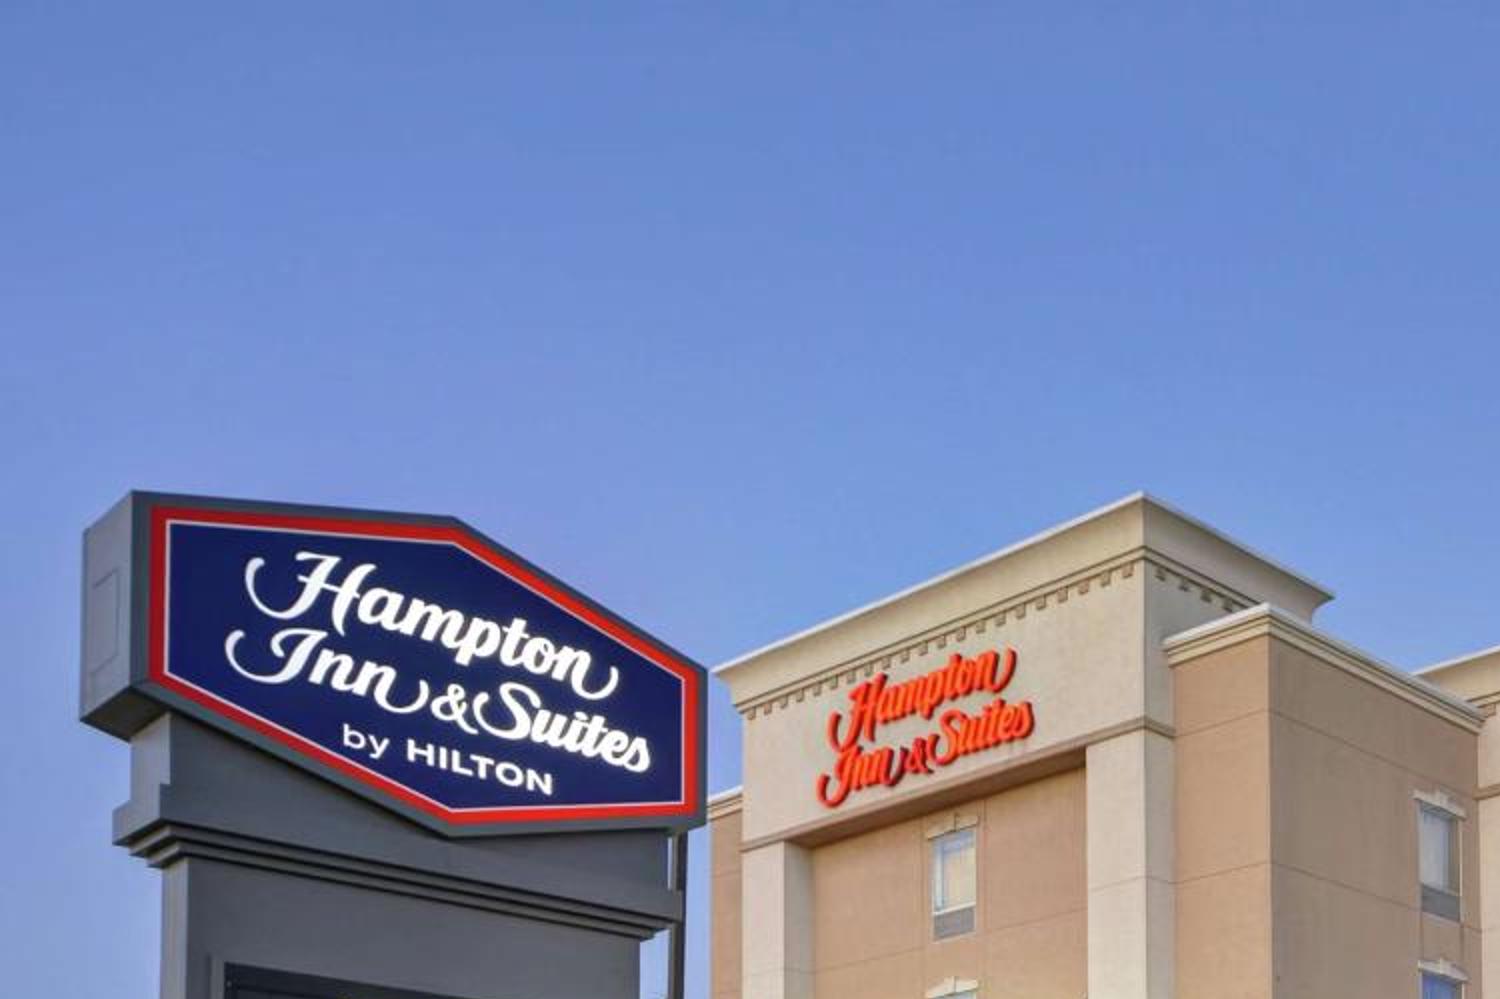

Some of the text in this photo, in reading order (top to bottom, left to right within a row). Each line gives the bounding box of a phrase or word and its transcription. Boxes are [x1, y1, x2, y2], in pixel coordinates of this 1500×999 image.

[245, 552, 619, 699] Hampton
[225, 628, 652, 773] Inn & Suites
[817, 743, 909, 808] Inn
[927, 697, 1035, 766] Suites
[827, 648, 1017, 753] Hampton
[342, 722, 554, 796] by HILTON
